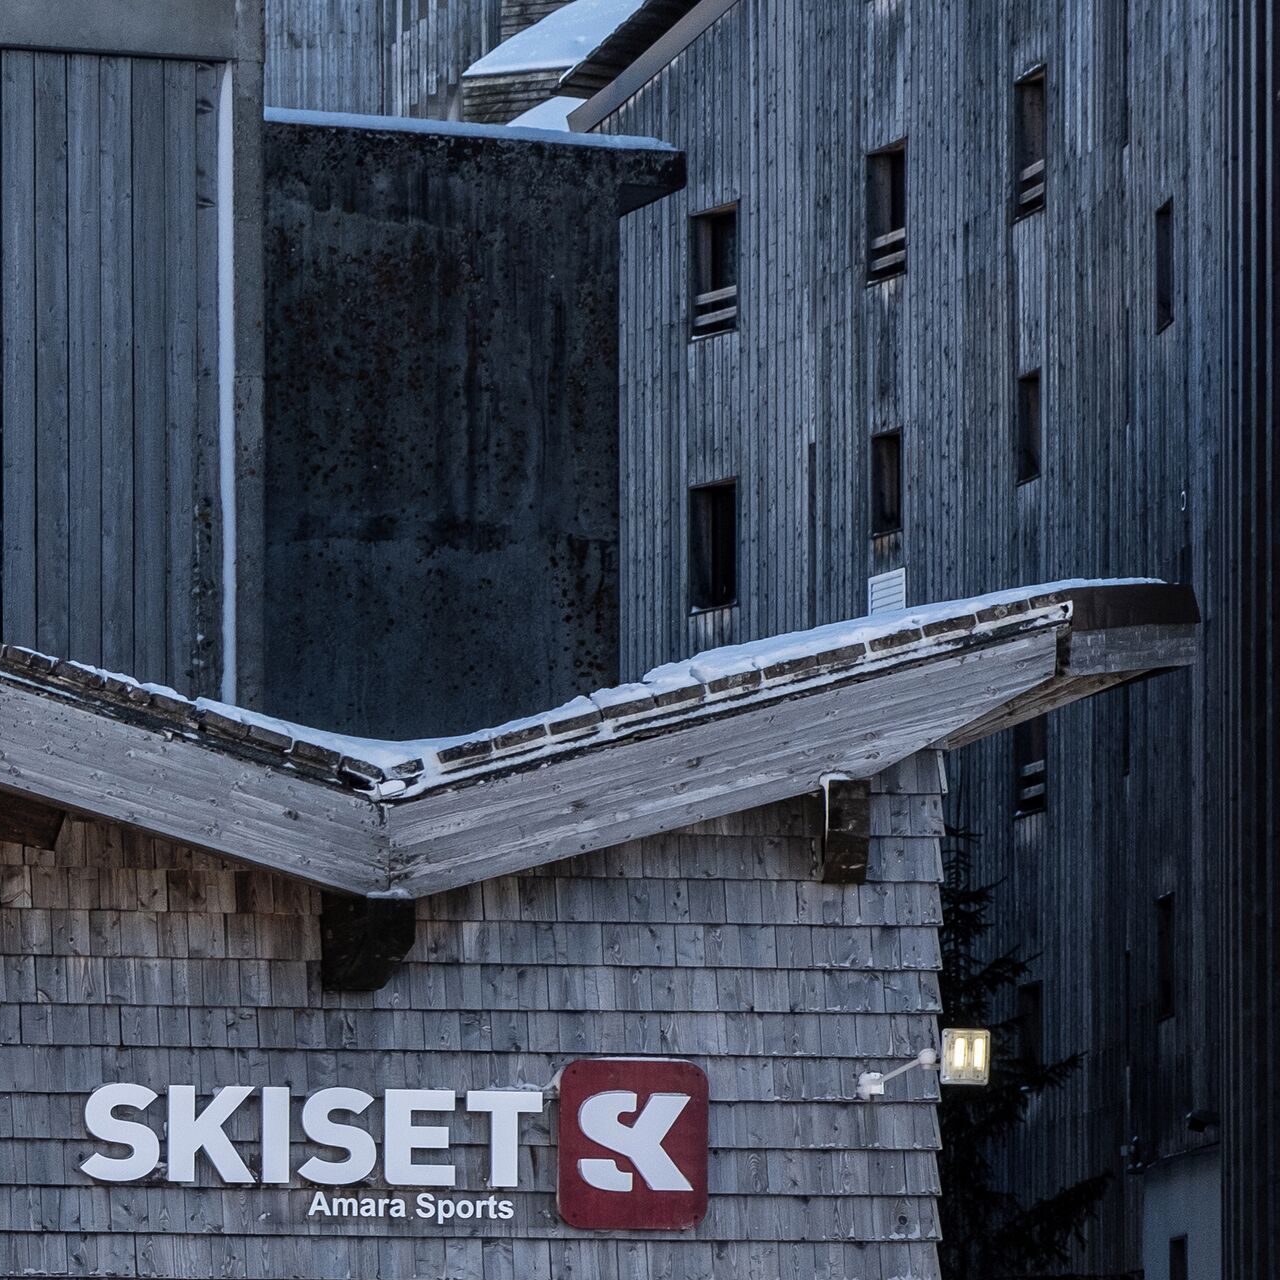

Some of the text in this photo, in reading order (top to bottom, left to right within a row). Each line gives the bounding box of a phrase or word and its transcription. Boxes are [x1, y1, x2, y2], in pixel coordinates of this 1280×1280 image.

[80, 1082, 543, 1187] SKISET
[307, 1191, 514, 1225] Amara Sports
